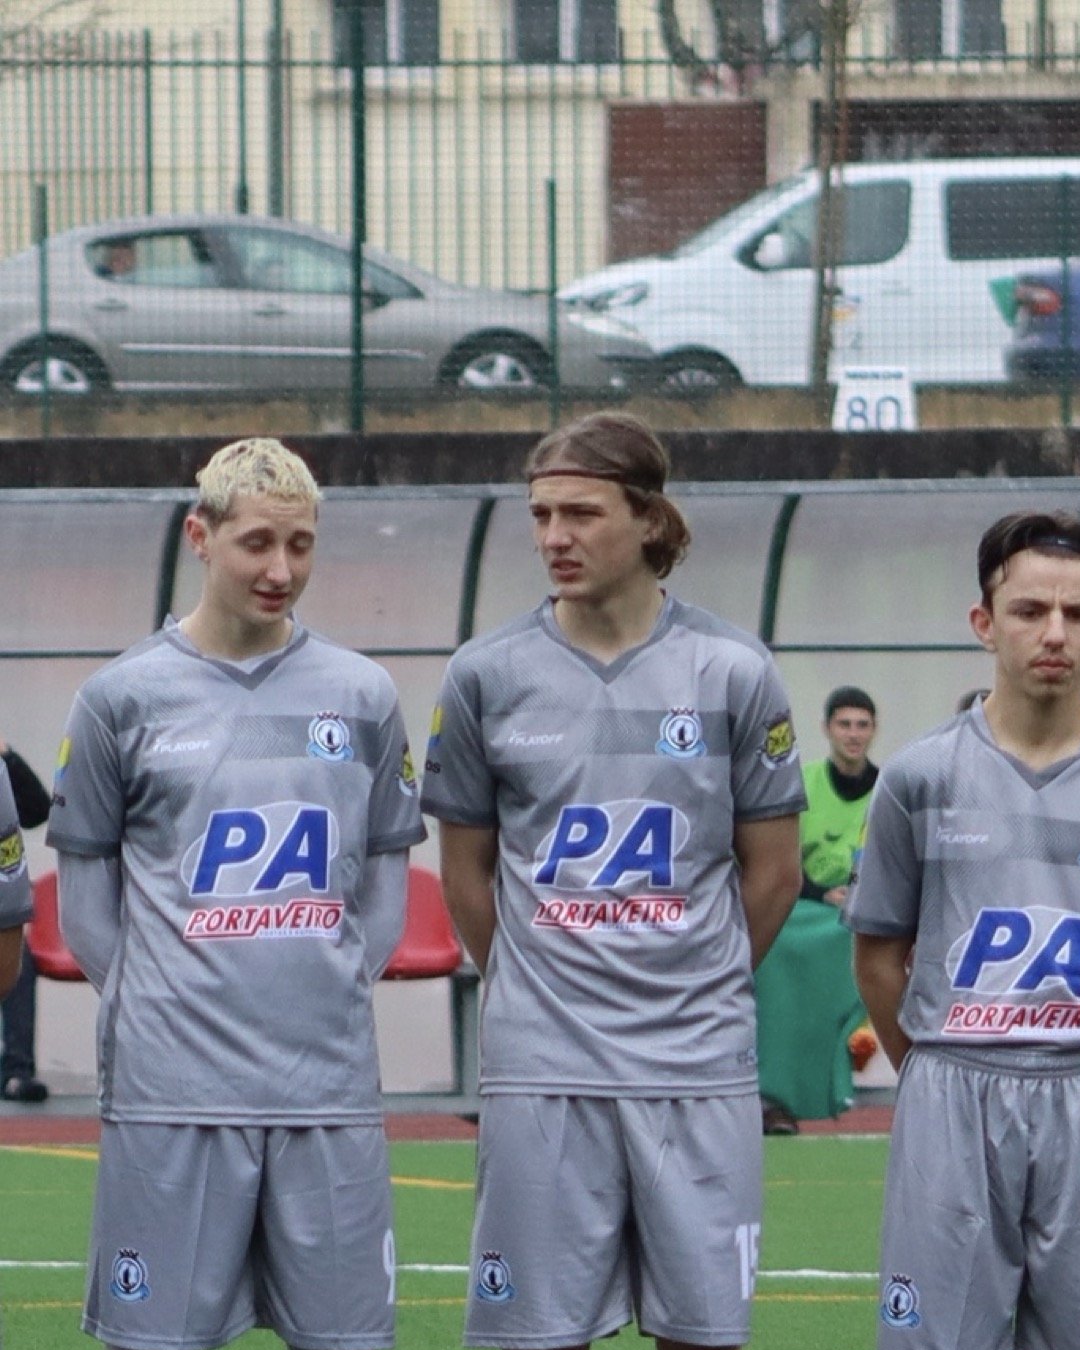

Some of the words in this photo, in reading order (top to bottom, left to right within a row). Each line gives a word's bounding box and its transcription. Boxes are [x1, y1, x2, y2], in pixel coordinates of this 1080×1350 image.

[847, 396, 901, 431] 80
[190, 808, 330, 895] PA
[534, 805, 674, 888] PA
[186, 901, 343, 937] PORTAVEIRO
